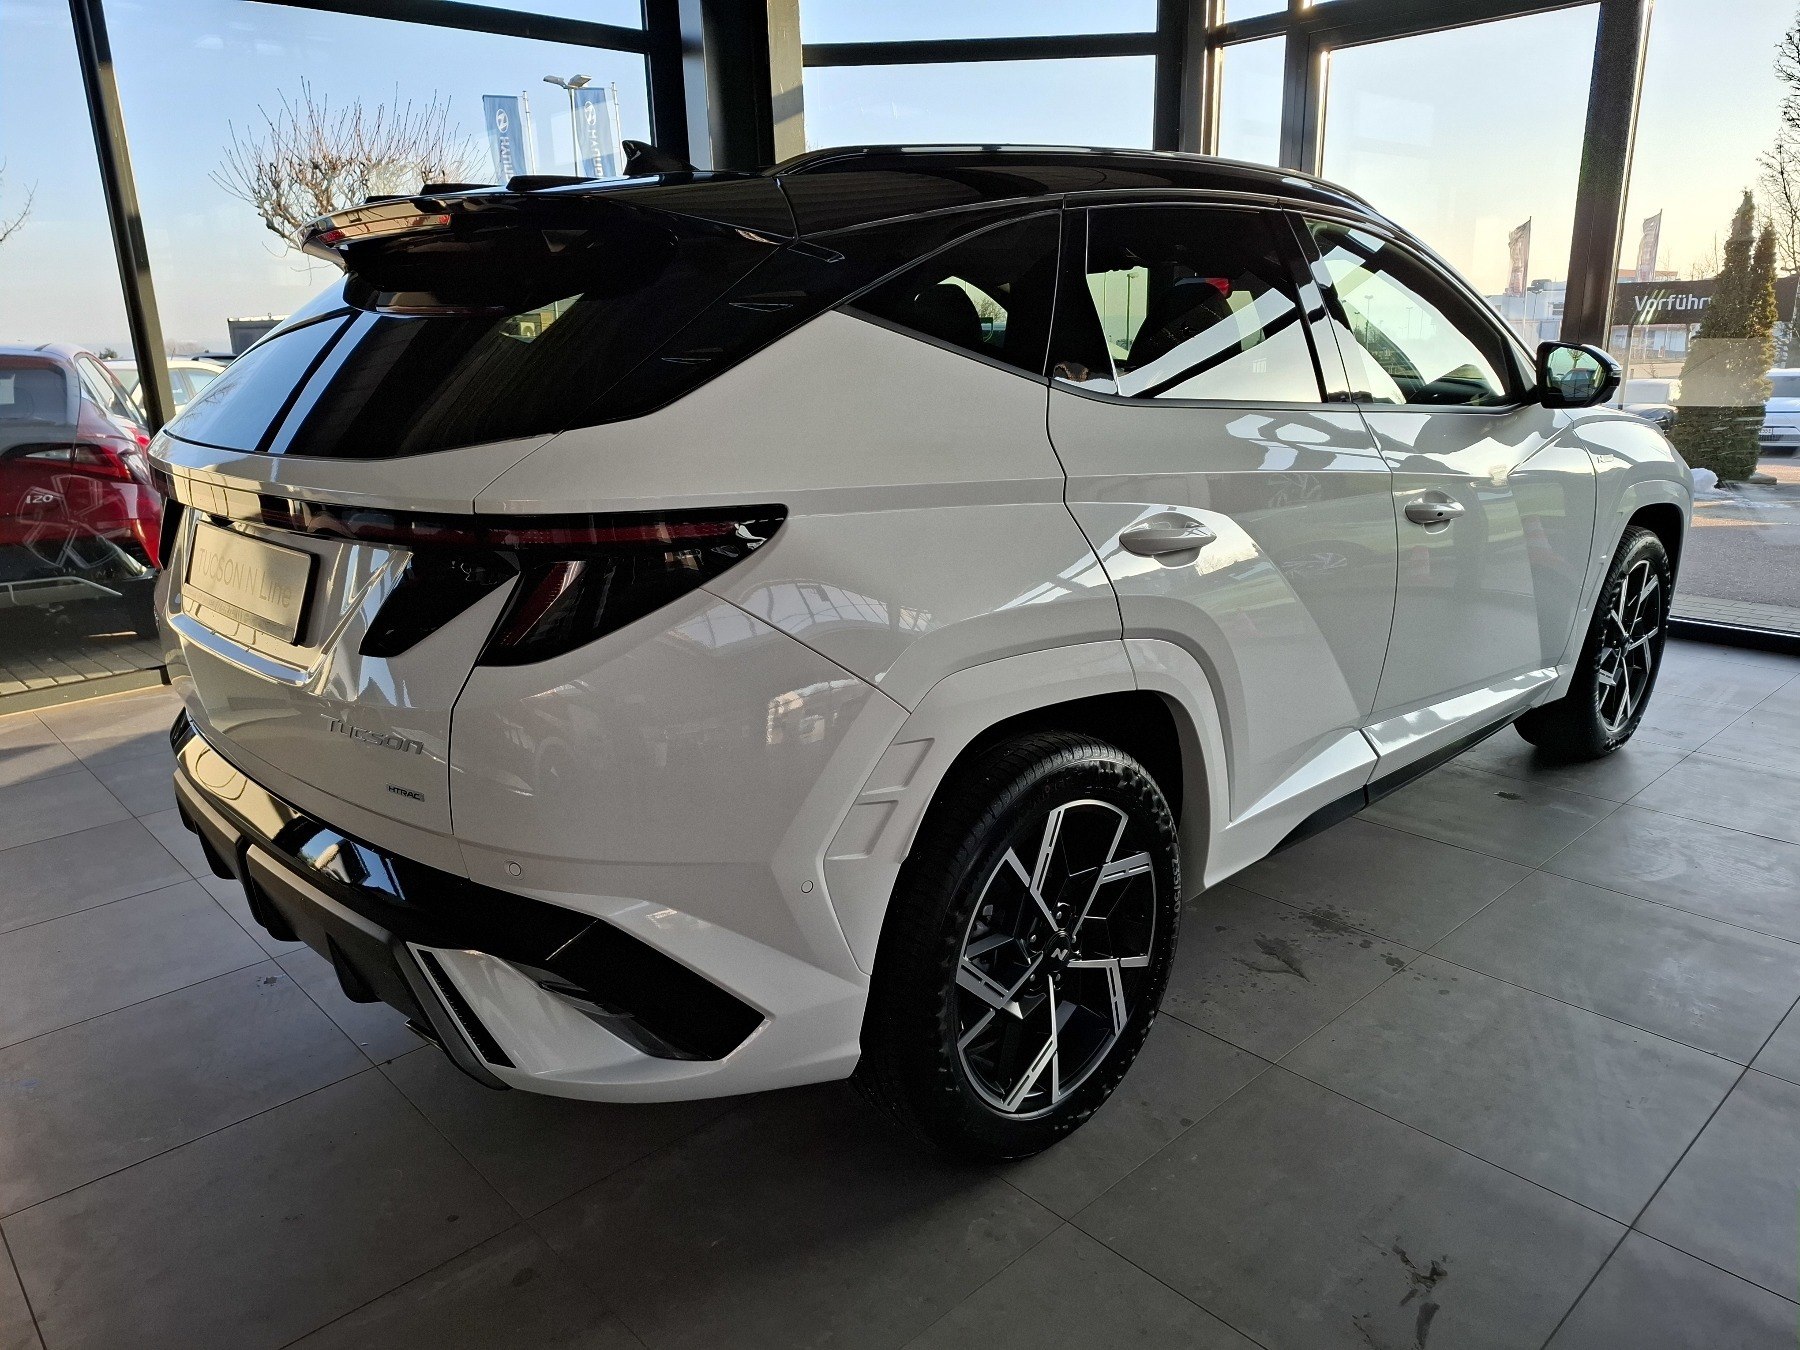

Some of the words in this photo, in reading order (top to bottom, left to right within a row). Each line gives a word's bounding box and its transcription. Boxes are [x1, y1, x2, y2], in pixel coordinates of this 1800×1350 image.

[1634, 293, 1712, 312] Vorführ
[199, 547, 245, 590] TUCSON
[245, 565, 258, 596] N
[258, 570, 292, 608] Line
[387, 784, 423, 801] HTRAC
